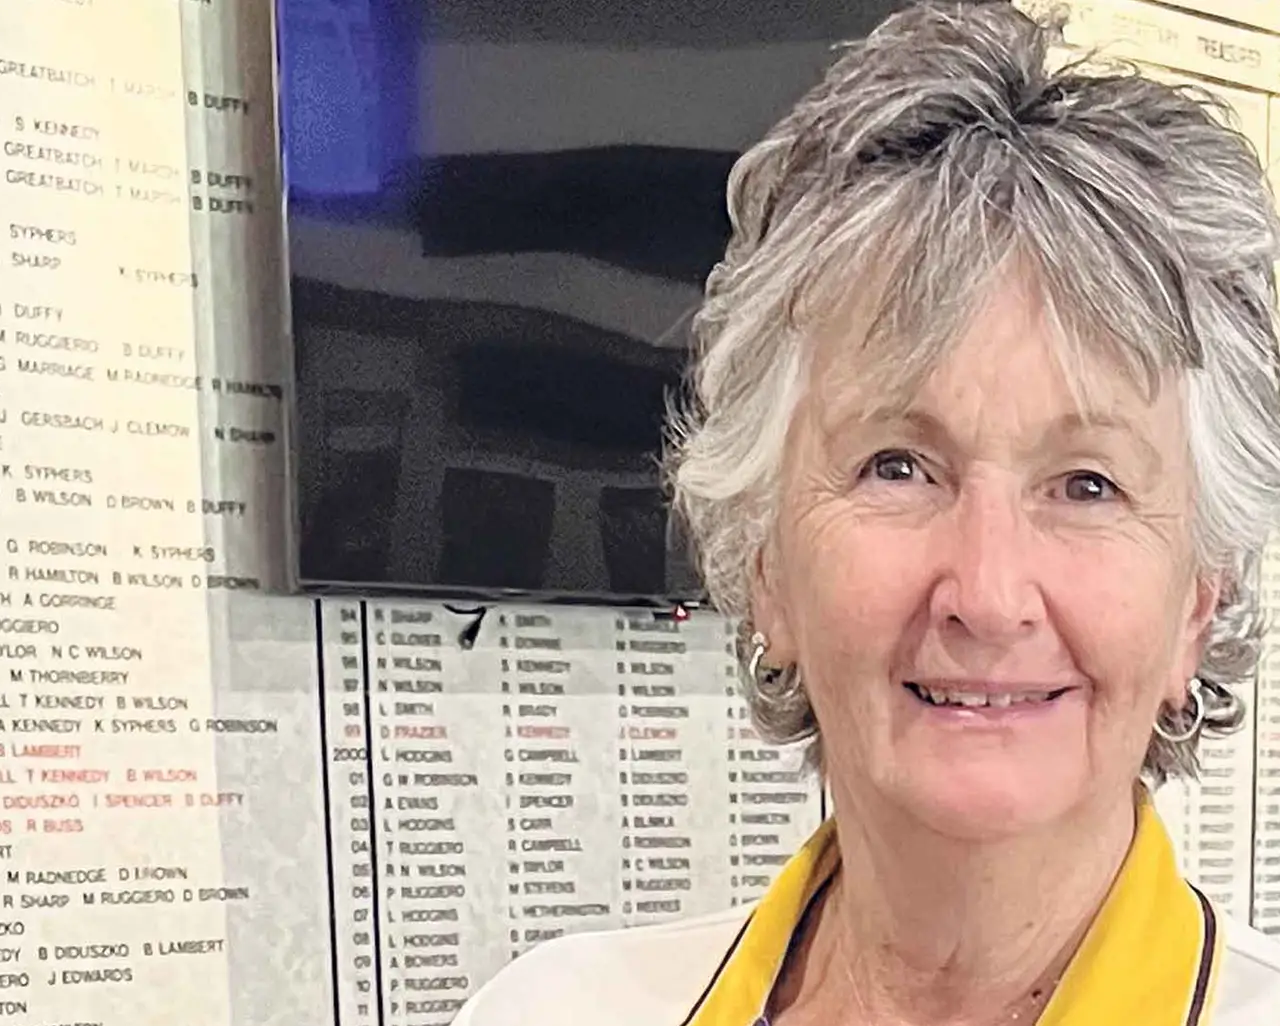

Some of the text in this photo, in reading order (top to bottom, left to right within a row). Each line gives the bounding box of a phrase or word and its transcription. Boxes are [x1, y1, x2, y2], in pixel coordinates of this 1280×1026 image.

[52, 646, 62, 658] N
[69, 645, 79, 659] C
[85, 646, 142, 660] WILSON
[30, 670, 128, 685] THORNBERRY
[35, 695, 104, 709] KENNEDY
[133, 697, 188, 710] WILSON
[12, 719, 81, 733] KENNEDY
[112, 719, 177, 733] SYPHERS
[206, 718, 278, 733] ROBINSON
[12, 744, 80, 758] LAMBERT
[333, 748, 367, 762] 2000
[398, 797, 438, 810] EVANS
[26, 868, 106, 884] RADNEDGE
[418, 864, 466, 877] WILSON
